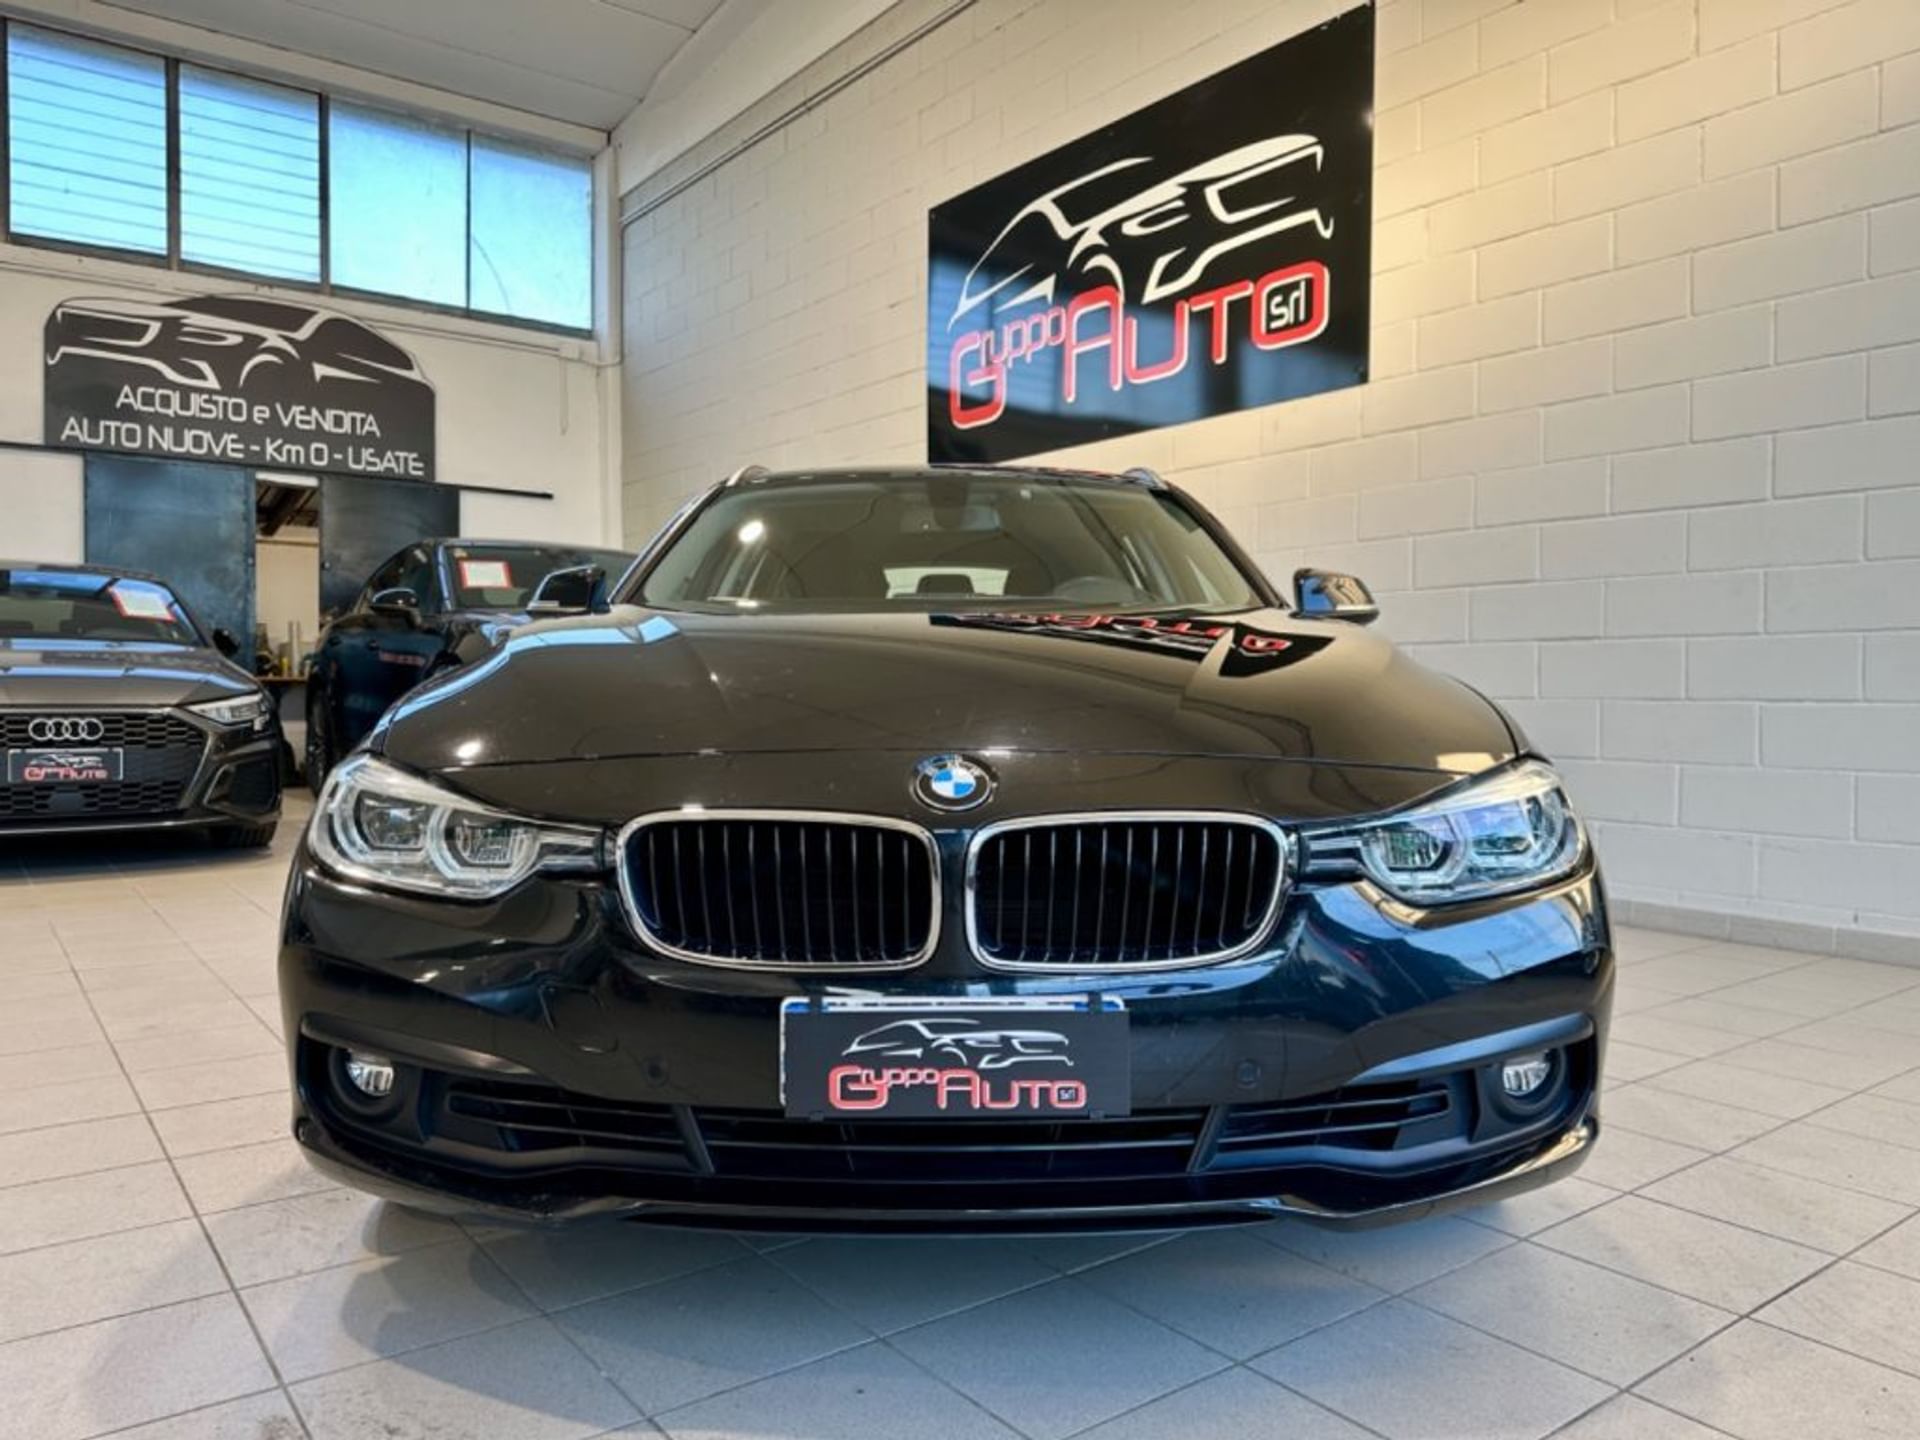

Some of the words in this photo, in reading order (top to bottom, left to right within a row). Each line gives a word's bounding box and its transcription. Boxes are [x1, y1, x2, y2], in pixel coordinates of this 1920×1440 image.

[1269, 279, 1306, 328] srl
[1063, 260, 1330, 403] AUTO
[115, 385, 246, 422] ACQUISTO
[253, 404, 270, 424] e
[276, 402, 380, 437] VENDITA
[61, 416, 140, 448] AUTO
[148, 428, 245, 460] NUOVE
[265, 438, 303, 464] Km
[347, 447, 424, 476] USATE
[938, 1069, 1087, 1110] AUTO
